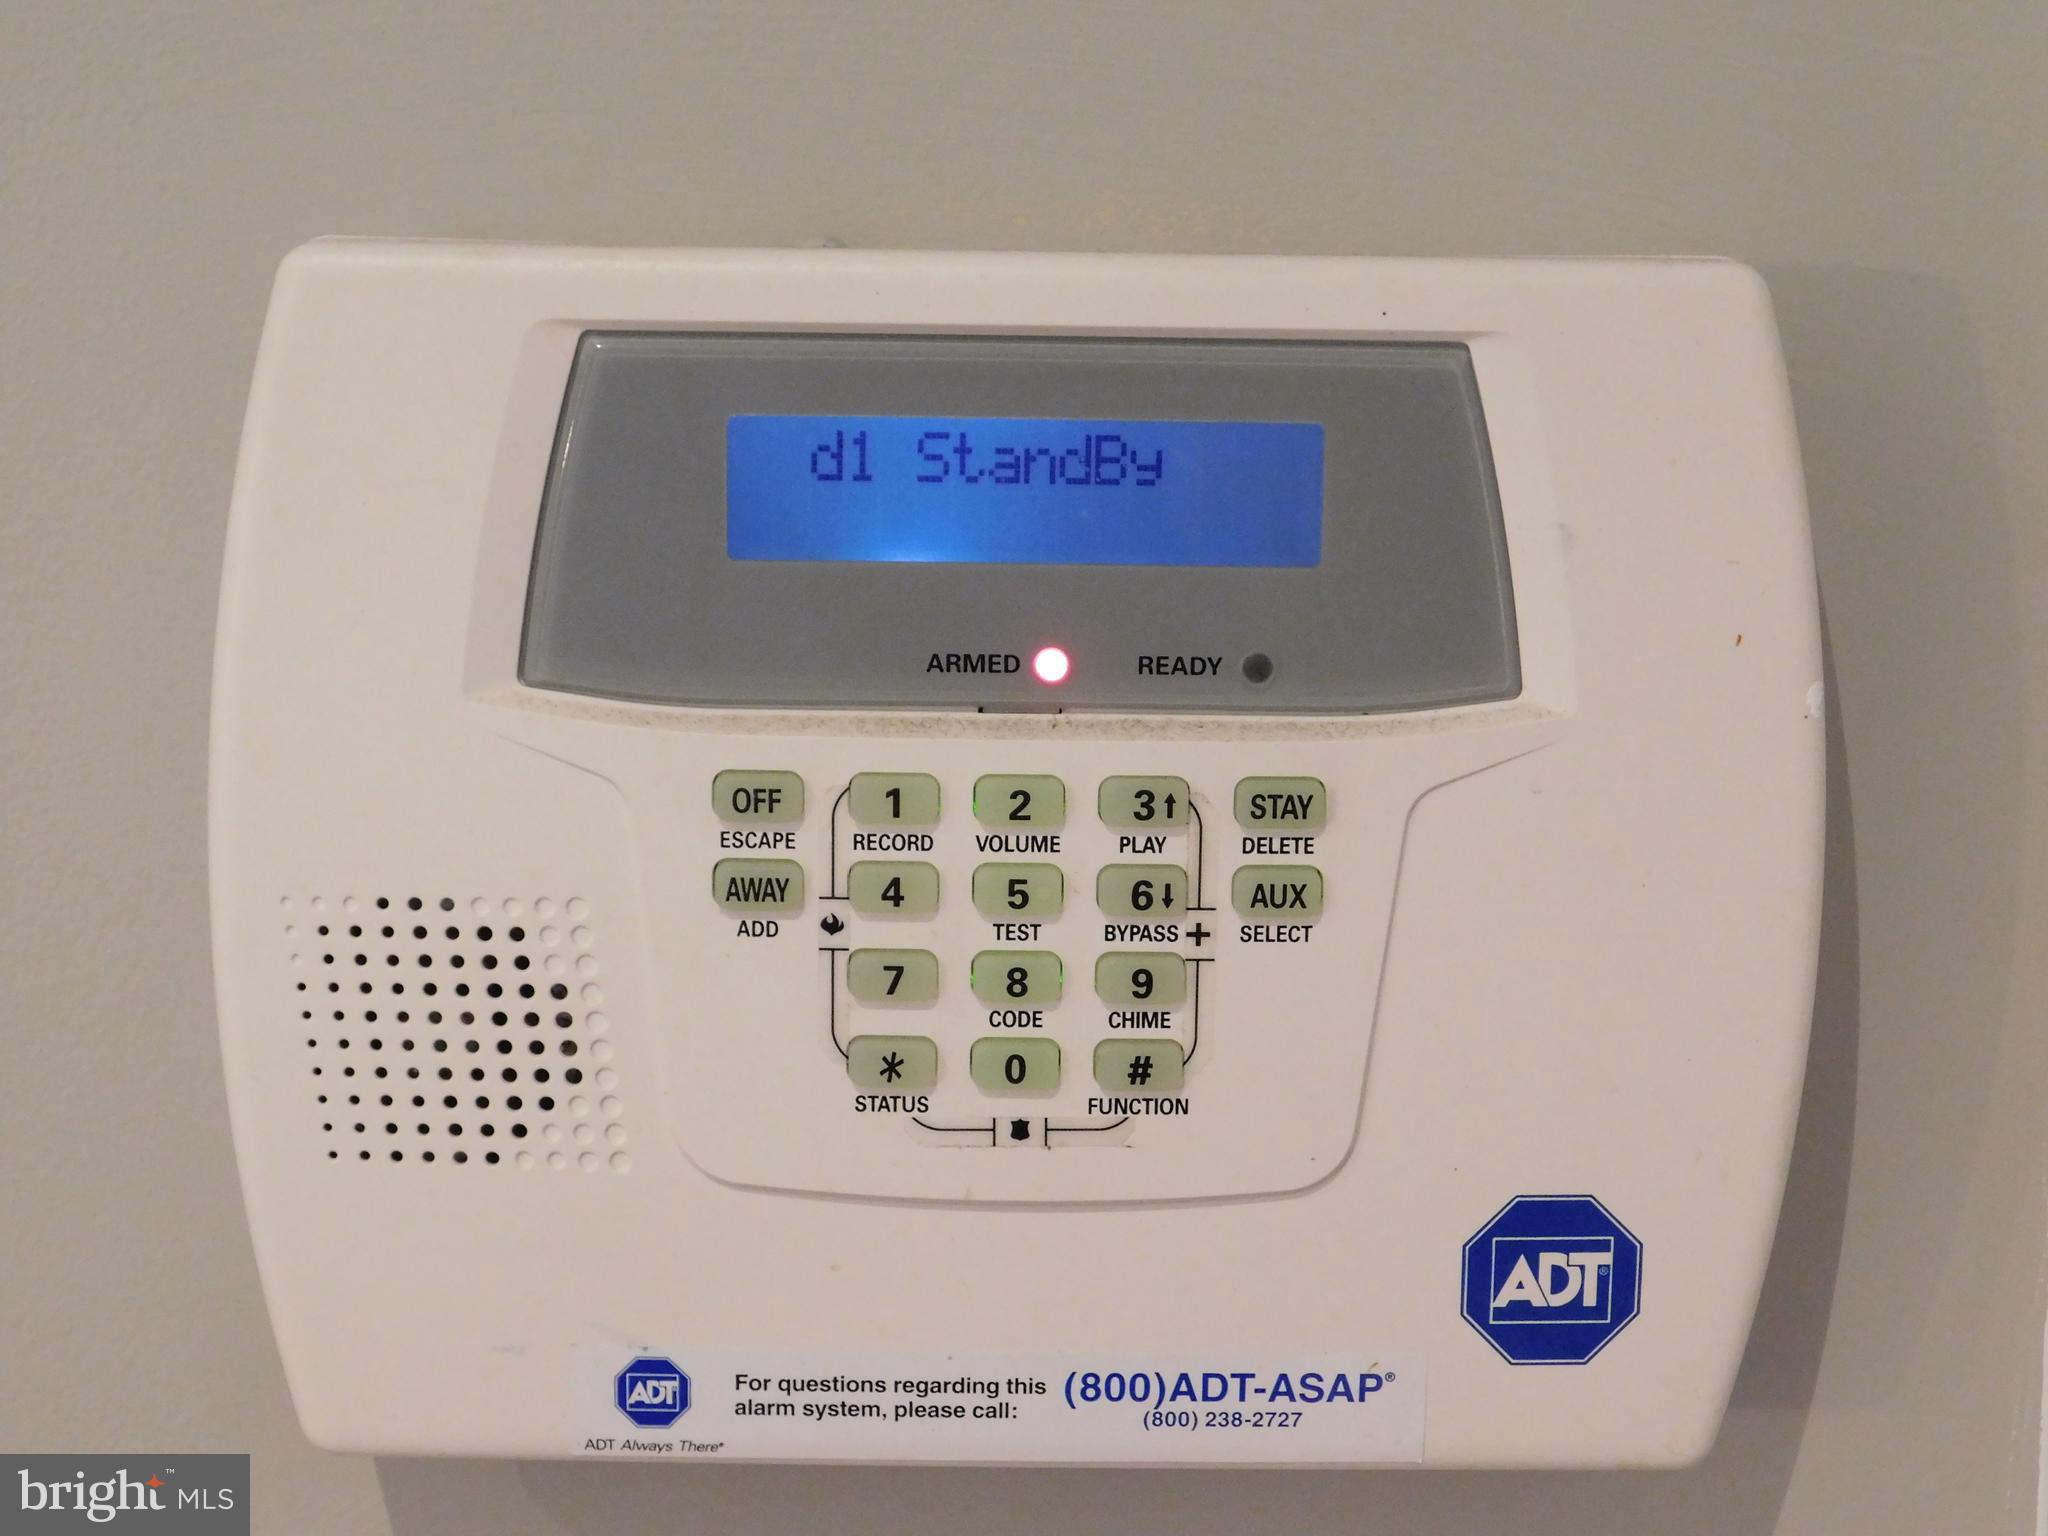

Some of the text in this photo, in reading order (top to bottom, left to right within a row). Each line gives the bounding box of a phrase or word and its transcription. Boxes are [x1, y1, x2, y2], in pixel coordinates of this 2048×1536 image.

[810, 430, 1164, 487] d1 StandBy
[926, 653, 1020, 675] ARMED
[1137, 655, 1223, 676] READY
[731, 787, 782, 814] OFF
[885, 788, 901, 818] 1
[1008, 790, 1032, 821] 2
[1132, 790, 1156, 820] 3
[1249, 794, 1314, 820] STAY
[719, 831, 796, 850] ESCAPE
[852, 834, 934, 853] RECORD
[975, 835, 1061, 854] VOLUME
[1118, 836, 1167, 855] PLAY
[1241, 837, 1315, 856] DELETE
[725, 876, 789, 904] AWAY
[880, 877, 905, 907] 4
[1006, 879, 1030, 910] 5
[1130, 880, 1154, 910] 6
[1250, 882, 1307, 909] AUX
[736, 920, 780, 939] ADD
[992, 923, 1042, 943] TEST
[1103, 924, 1180, 944] BYPASS
[1239, 925, 1314, 944] SELECT
[883, 966, 905, 996] 7
[1005, 967, 1029, 998] 8
[1131, 968, 1154, 999] 9
[988, 1010, 1044, 1029] CODE
[1108, 1011, 1172, 1030] CHIME
[1004, 1054, 1027, 1085] 0
[1128, 1056, 1154, 1086] #
[854, 1095, 930, 1114] STATUS
[1087, 1097, 1190, 1116] FUNCTION
[734, 1374, 1047, 1398] For questions regarding this
[734, 1399, 1019, 1421] alarm system, please call:
[1143, 1411, 1303, 1431] (800) 238-2727
[584, 1439, 616, 1451] ADT
[620, 1440, 674, 1454] Always
